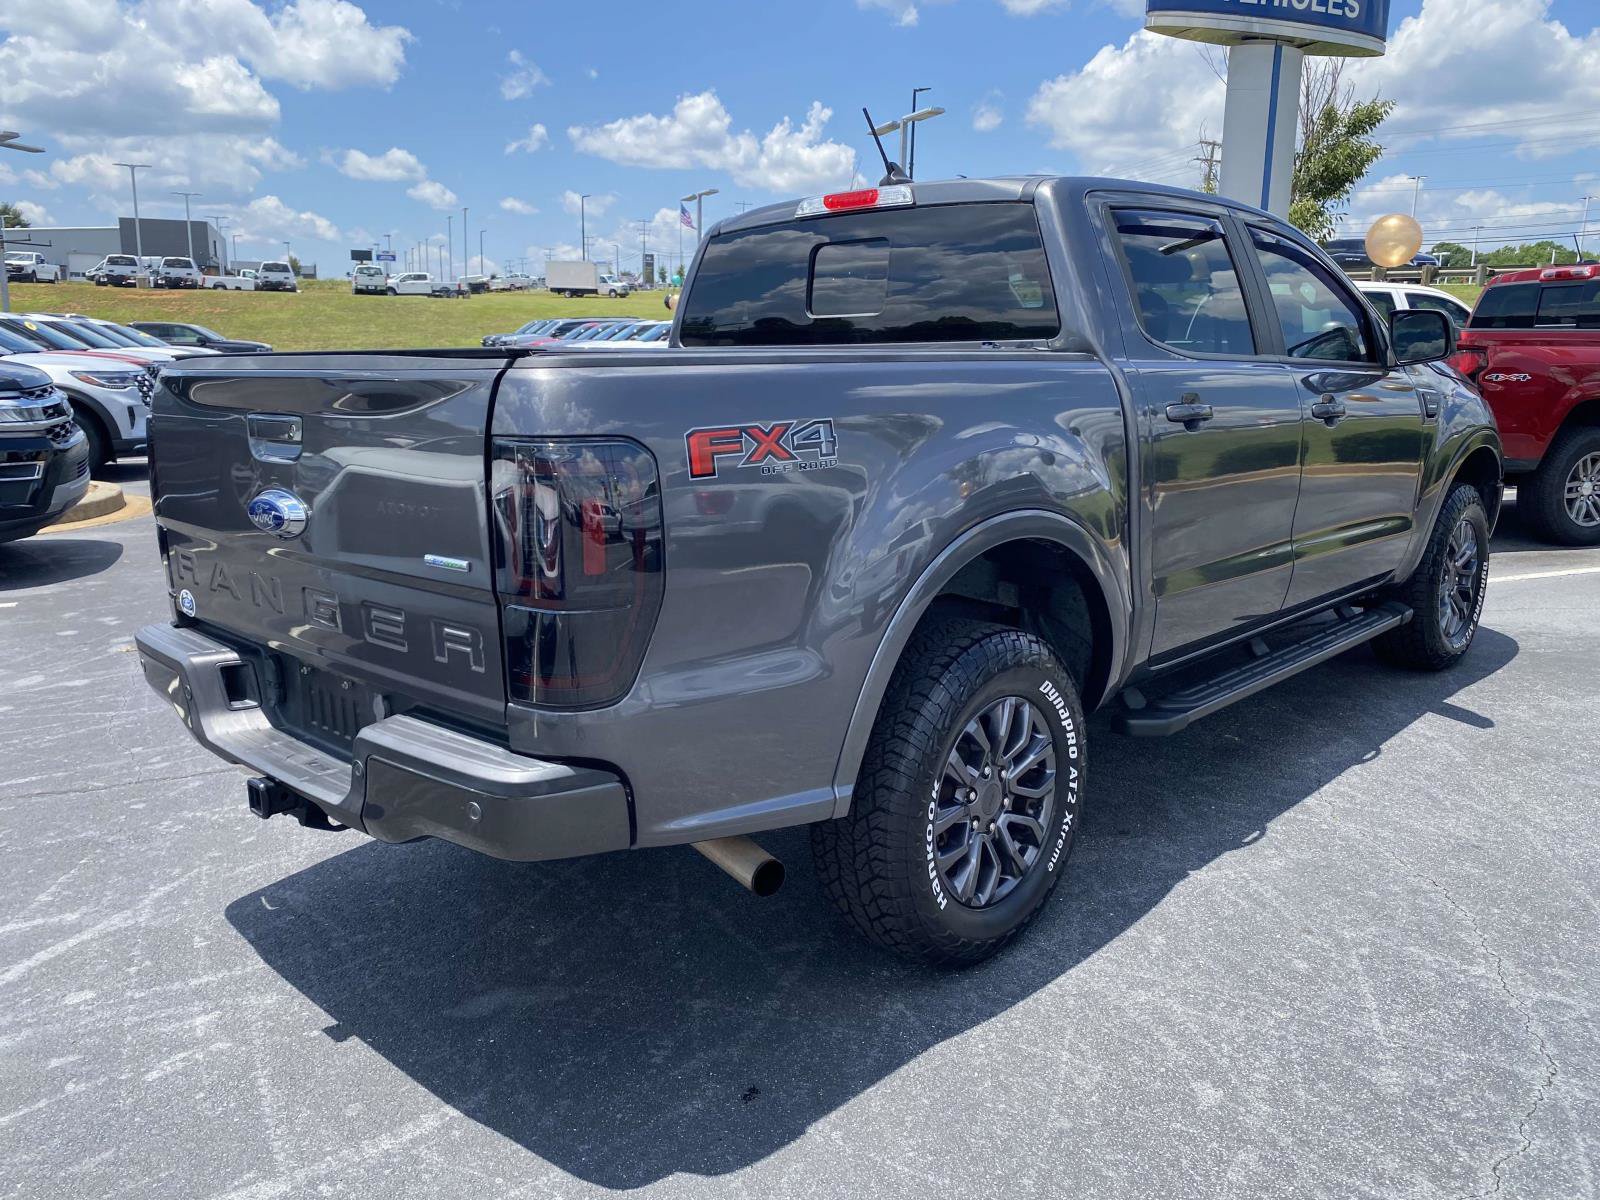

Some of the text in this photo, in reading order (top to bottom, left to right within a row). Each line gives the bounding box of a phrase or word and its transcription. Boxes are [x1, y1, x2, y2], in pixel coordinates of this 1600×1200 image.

[684, 418, 838, 480] FX4
[761, 459, 839, 476] OFF ROAD
[172, 545, 485, 673] RANGER
[1067, 766, 1078, 804] AT2
[1047, 810, 1073, 872] Xtreme
